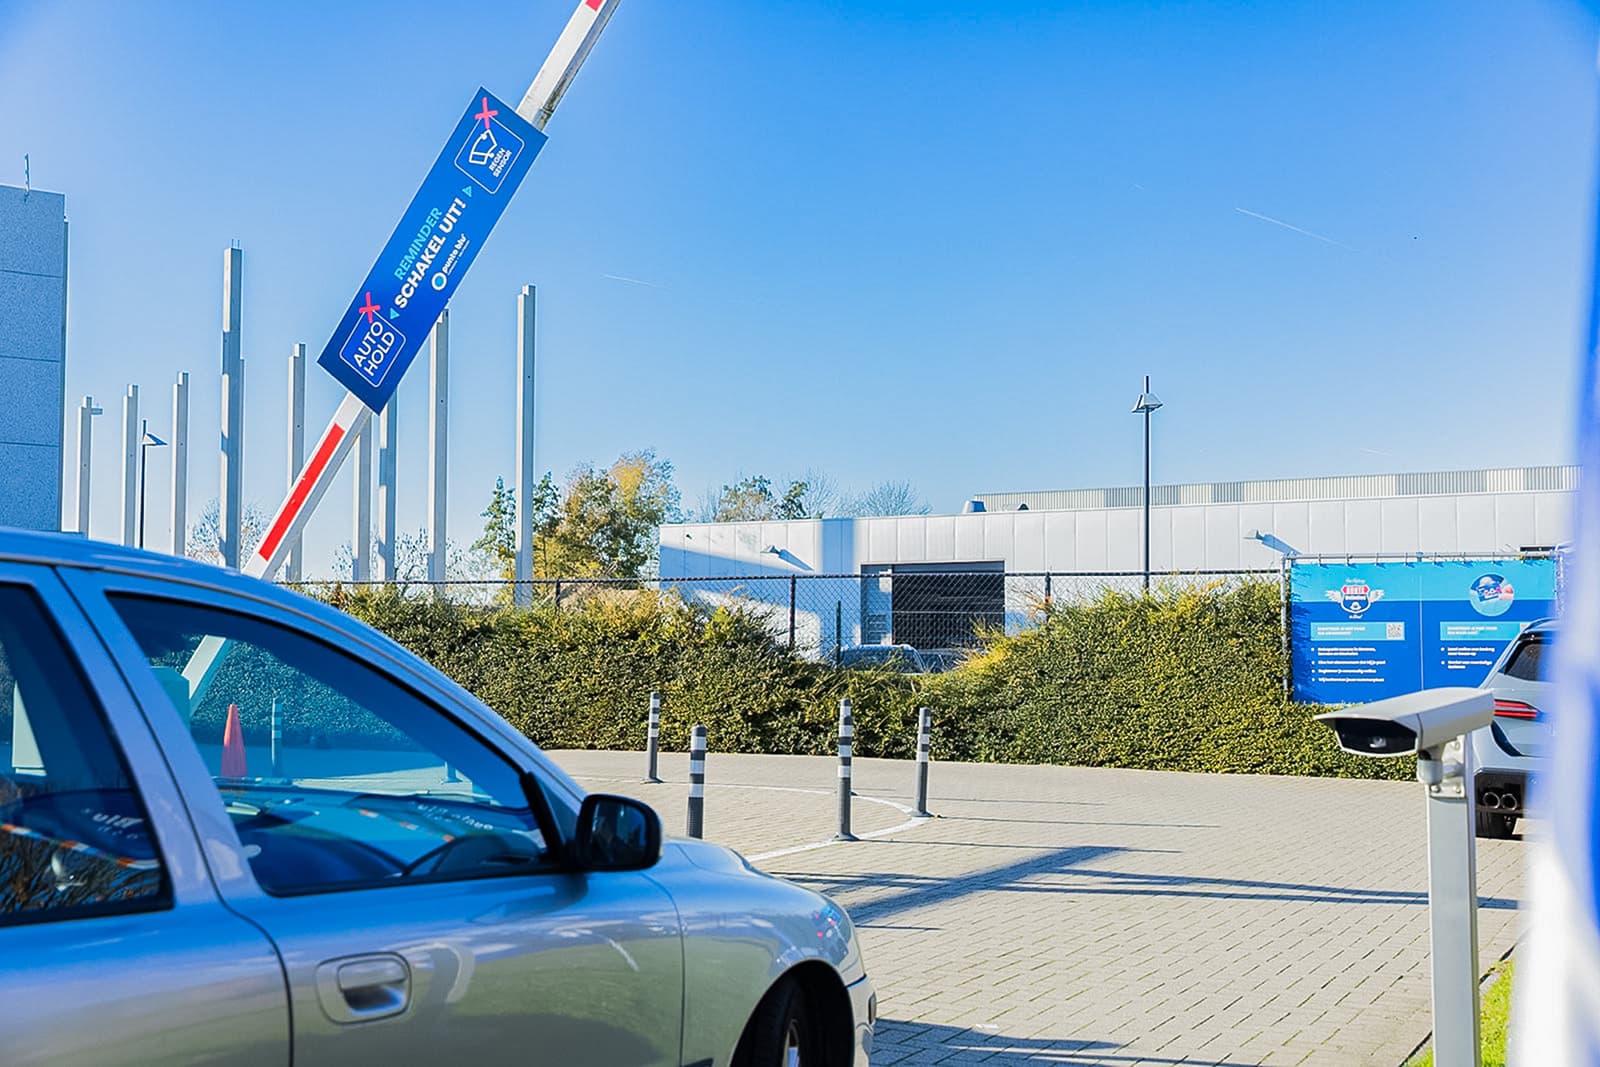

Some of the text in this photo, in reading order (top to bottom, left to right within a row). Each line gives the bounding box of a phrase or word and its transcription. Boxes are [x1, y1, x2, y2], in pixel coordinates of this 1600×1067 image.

[489, 148, 506, 171] REGEN
[493, 150, 512, 177] SENSOR
[394, 207, 442, 280] REMINDER
[394, 235, 446, 308] SCHAKEL
[439, 197, 466, 233] UIT!
[353, 321, 383, 367] AUTO
[363, 332, 395, 376] HOLD
